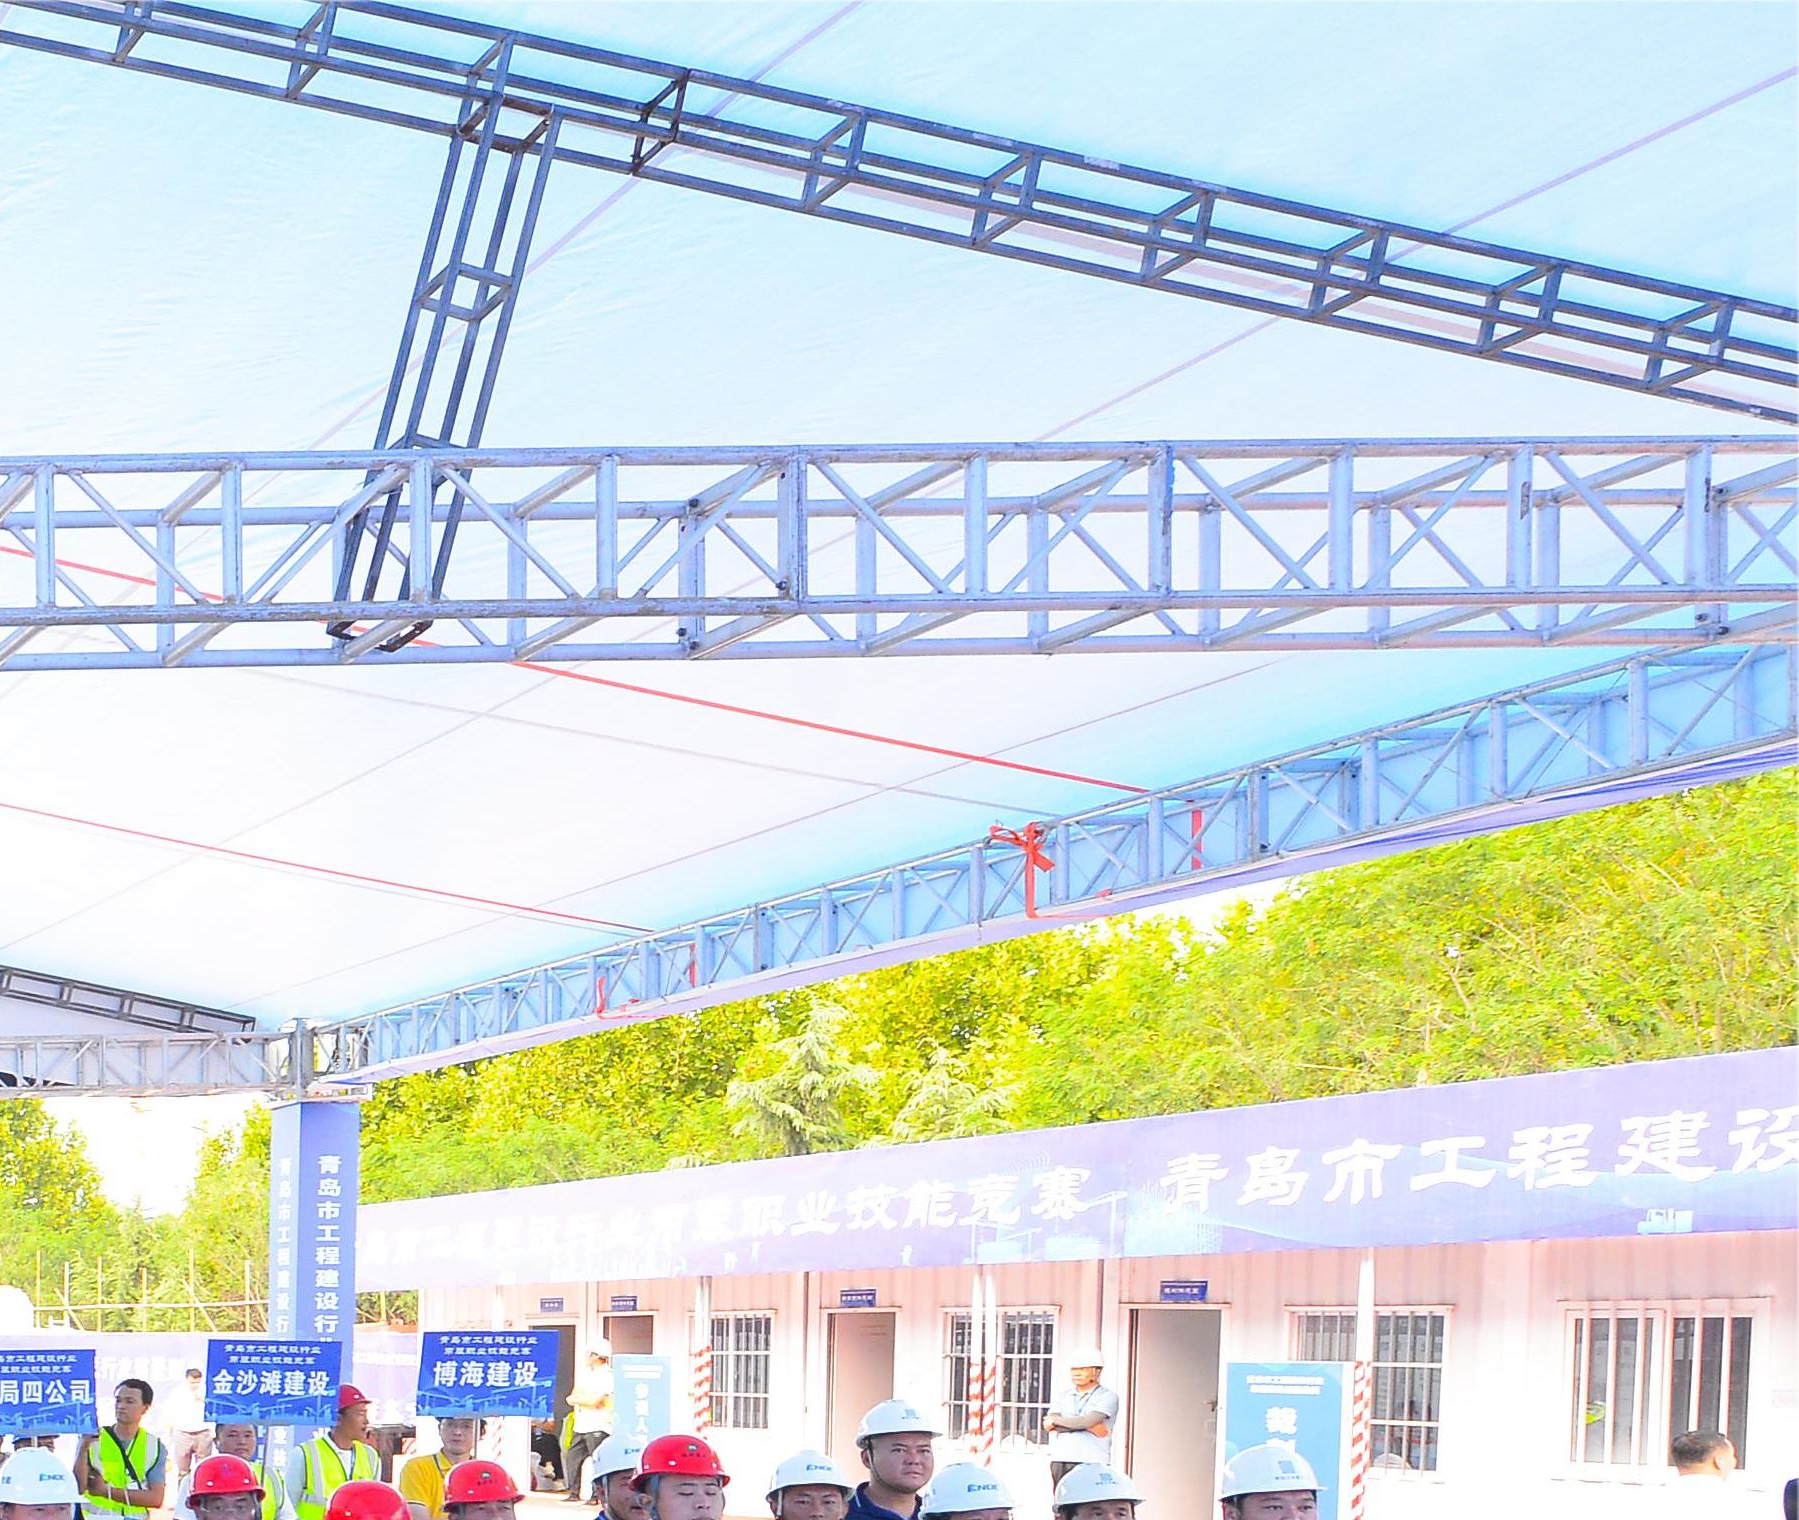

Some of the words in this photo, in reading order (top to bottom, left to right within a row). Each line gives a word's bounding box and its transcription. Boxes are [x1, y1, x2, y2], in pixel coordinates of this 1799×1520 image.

[213, 1370, 329, 1397] 金沙滩建设
[433, 1360, 538, 1388] 博海建设
